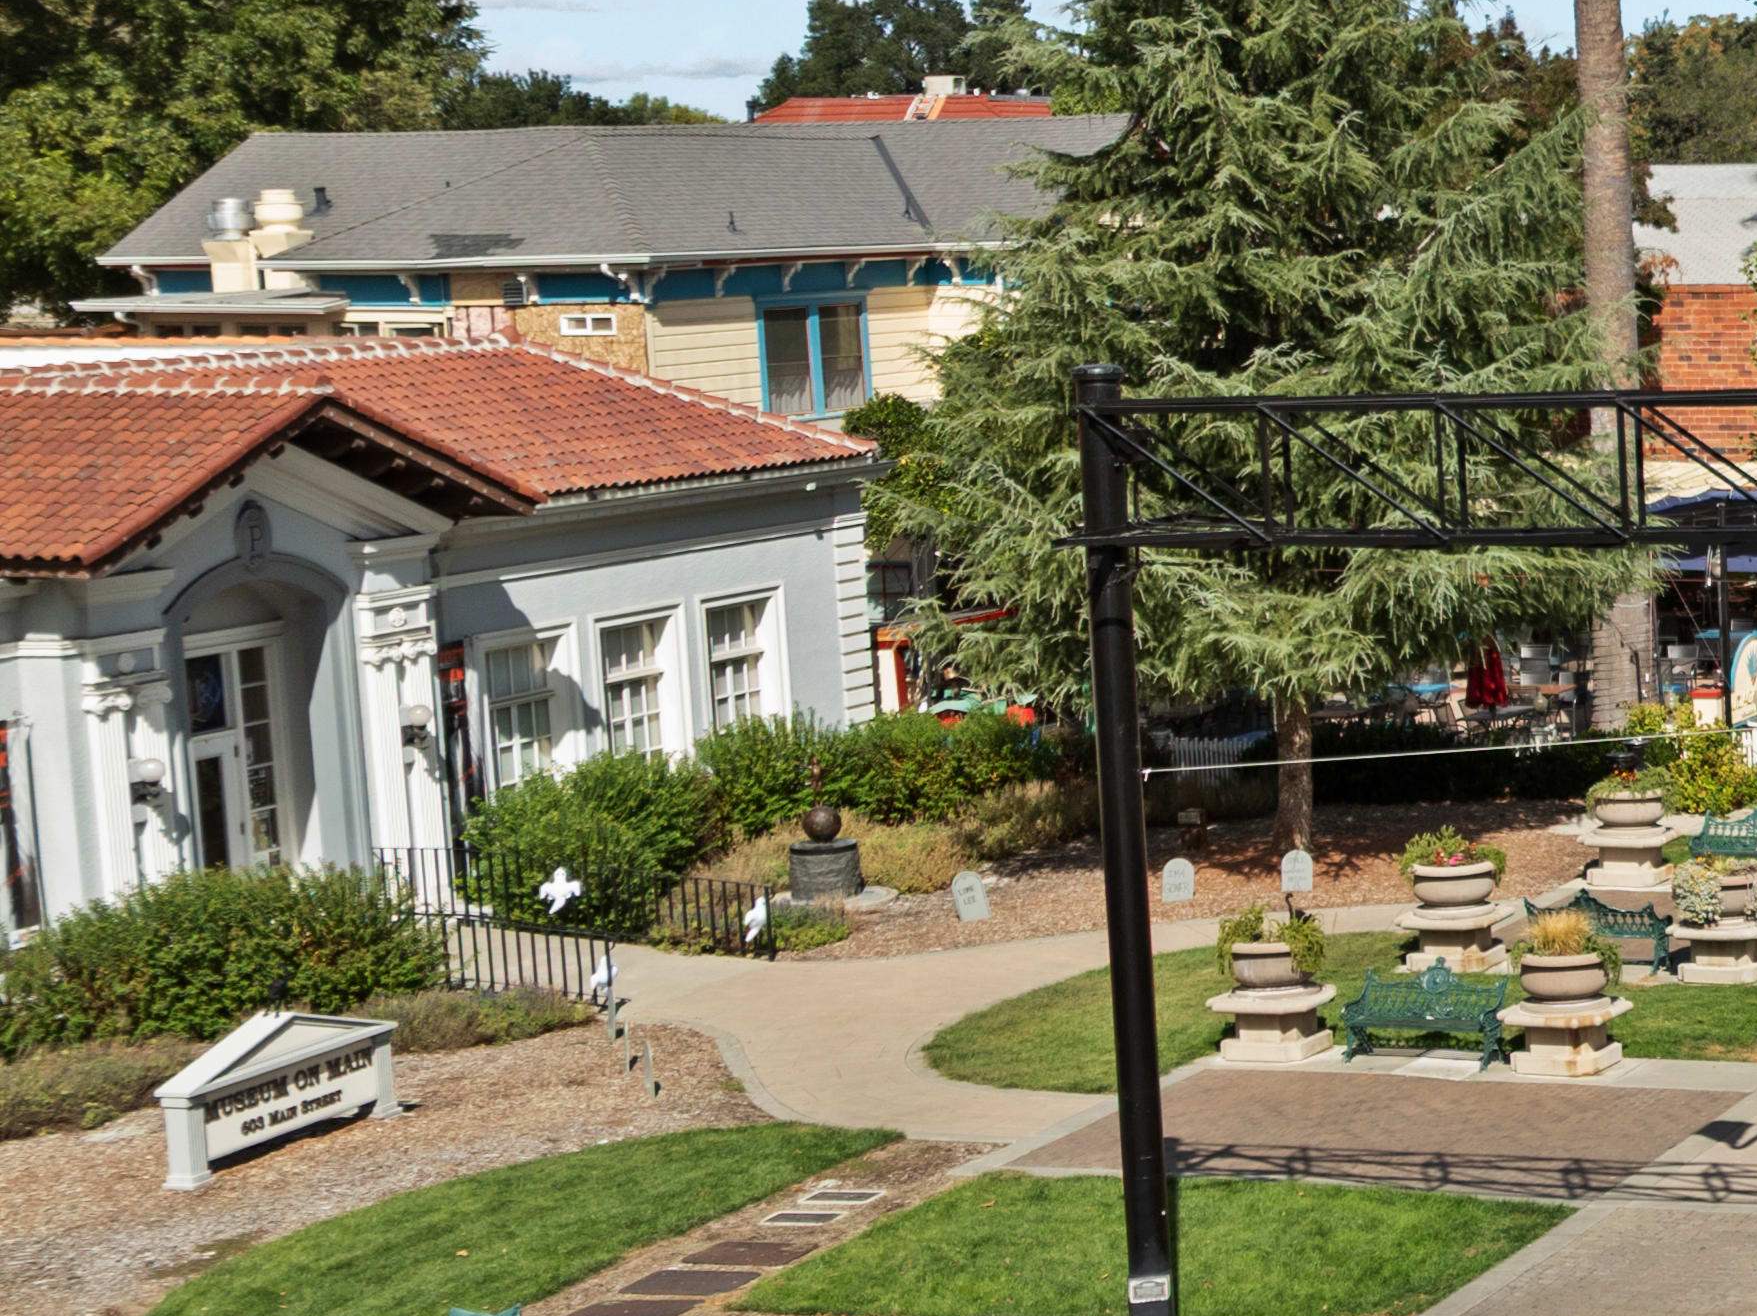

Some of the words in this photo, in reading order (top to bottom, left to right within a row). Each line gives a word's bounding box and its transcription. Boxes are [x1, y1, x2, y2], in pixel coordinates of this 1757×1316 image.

[205, 1076, 290, 1124] MUSEUM
[294, 1064, 321, 1091] ON
[325, 1046, 374, 1081] MAIN
